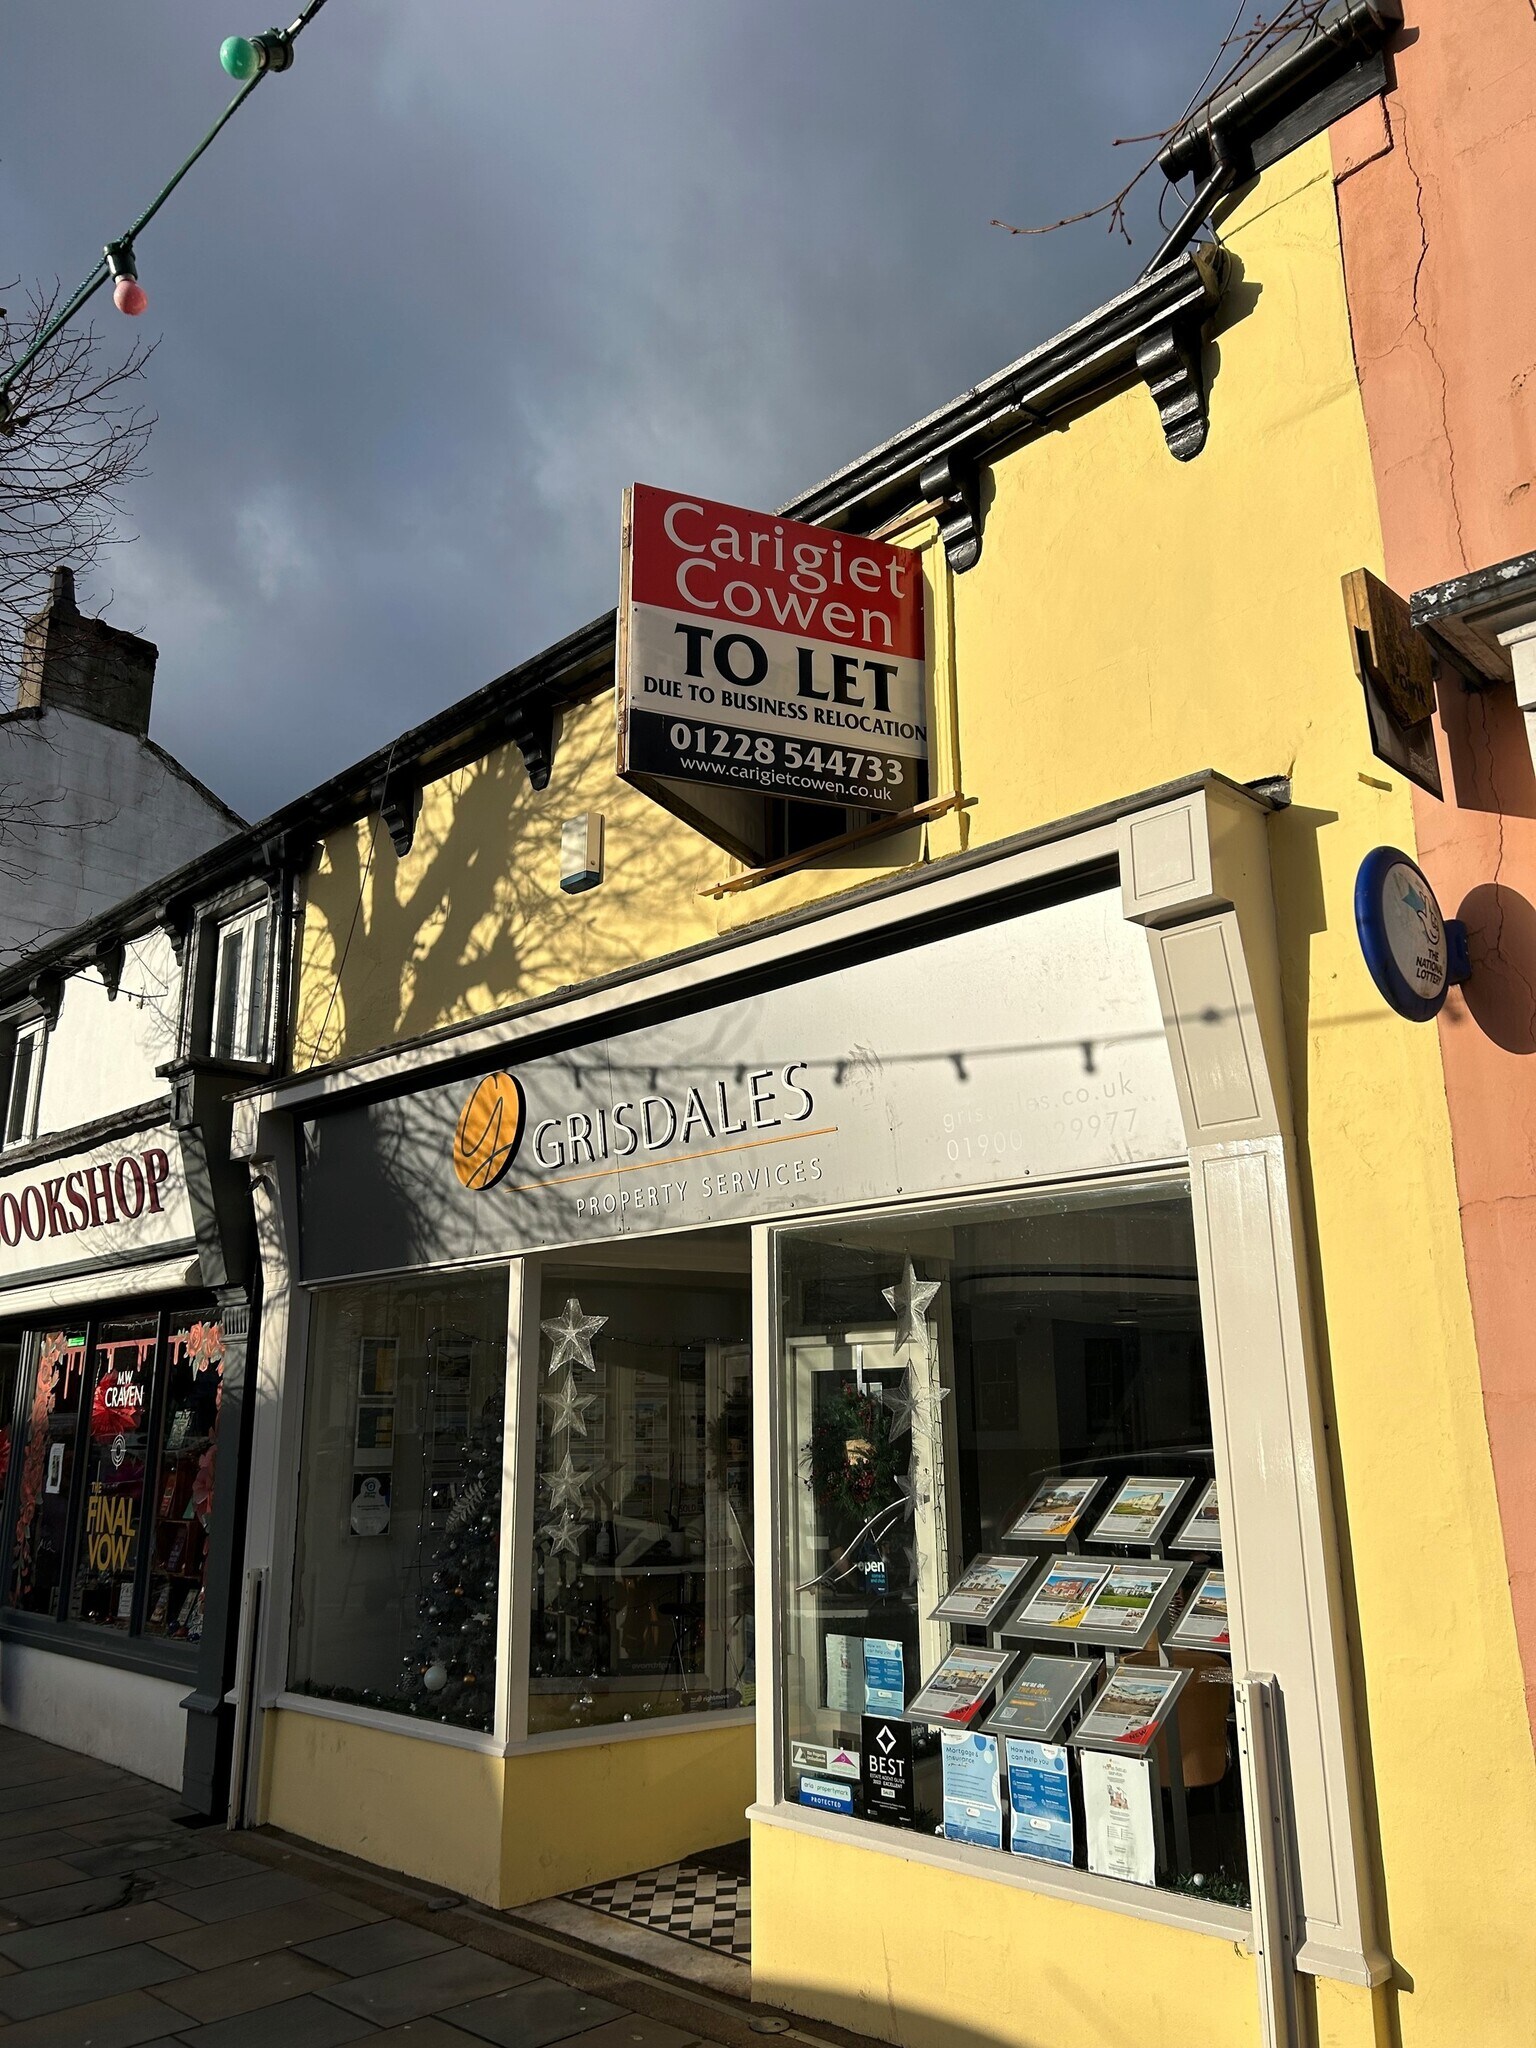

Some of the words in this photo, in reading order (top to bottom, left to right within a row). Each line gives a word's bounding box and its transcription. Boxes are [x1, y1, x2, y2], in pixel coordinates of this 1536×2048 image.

[663, 501, 906, 599] Carigiet
[675, 557, 894, 647] Cowen
[674, 623, 768, 686] TO
[795, 646, 898, 713] LET
[643, 675, 683, 698] DUE
[688, 684, 715, 704] TO
[721, 690, 808, 720] BUSINESS
[813, 707, 928, 742] RELOCATION
[669, 722, 775, 765] 01228
[783, 741, 904, 785] 544733
[679, 755, 892, 801] www.carigietcowen.co.uk
[1415, 956, 1443, 976] NATIONAL
[1427, 948, 1439, 961] THE
[1416, 967, 1442, 985] LOTTERY
[942, 1071, 1134, 1134] grisles.co.uk
[532, 1062, 814, 1170] GRISDALES
[946, 1128, 1023, 1161] 01900
[1041, 1107, 1138, 1144] 29977
[576, 1179, 688, 1219] PROPERTY
[702, 1156, 824, 1198] SERVICES
[104, 1385, 144, 1408] CRAVEN
[86, 1496, 136, 1537] FINAL
[87, 1533, 131, 1573] VOW
[857, 1561, 885, 1576] open
[955, 1704, 971, 1714] NEW
[1129, 1729, 1147, 1740] NEW
[946, 1746, 974, 1758] Mortgage
[946, 1754, 975, 1764] Insurance
[1010, 1745, 1024, 1754] How
[1024, 1755, 1038, 1764] help
[868, 1754, 905, 1777] BEST
[816, 1785, 849, 1796] propertymark
[882, 1781, 903, 1789] EXCELLENT
[810, 1796, 842, 1808] PROTECTED
